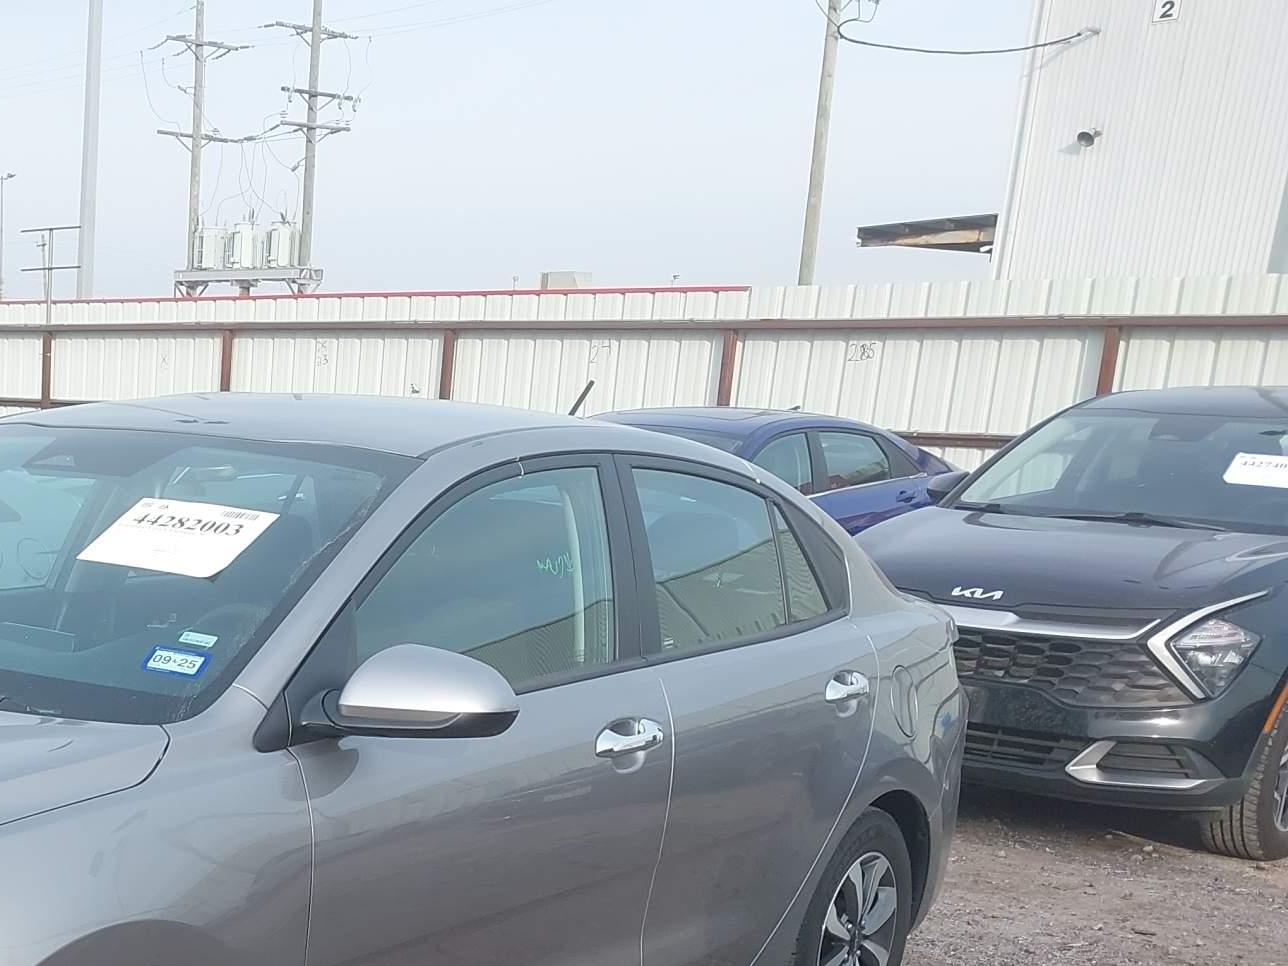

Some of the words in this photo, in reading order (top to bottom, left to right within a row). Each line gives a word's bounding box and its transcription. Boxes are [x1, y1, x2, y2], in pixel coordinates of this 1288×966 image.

[1159, 0, 1175, 19] 2
[133, 512, 245, 536] 44282003
[152, 653, 172, 665] 09
[177, 657, 199, 669] 25
